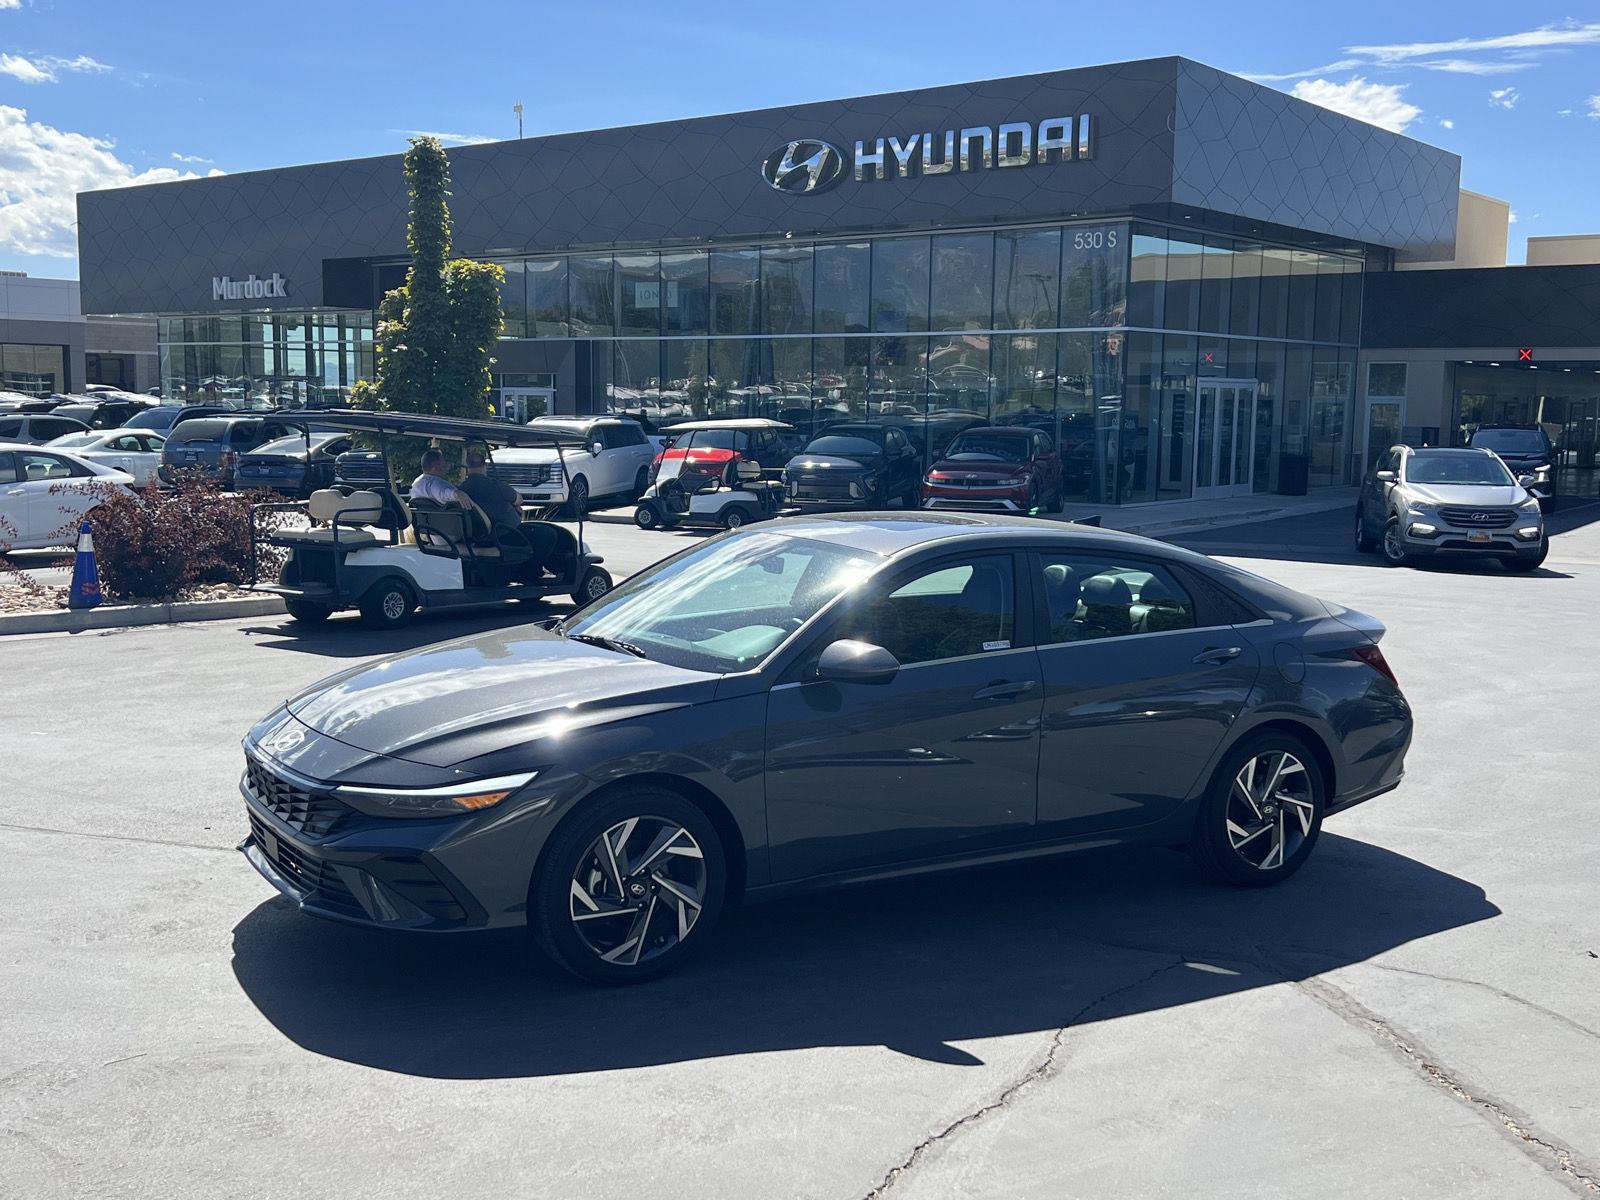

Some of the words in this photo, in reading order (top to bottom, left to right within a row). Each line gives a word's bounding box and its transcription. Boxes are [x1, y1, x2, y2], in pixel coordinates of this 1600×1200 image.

[854, 113, 1092, 182] HYUNDAI
[1074, 231, 1103, 250] 530
[1107, 230, 1117, 248] S
[212, 272, 287, 300] Murdock
